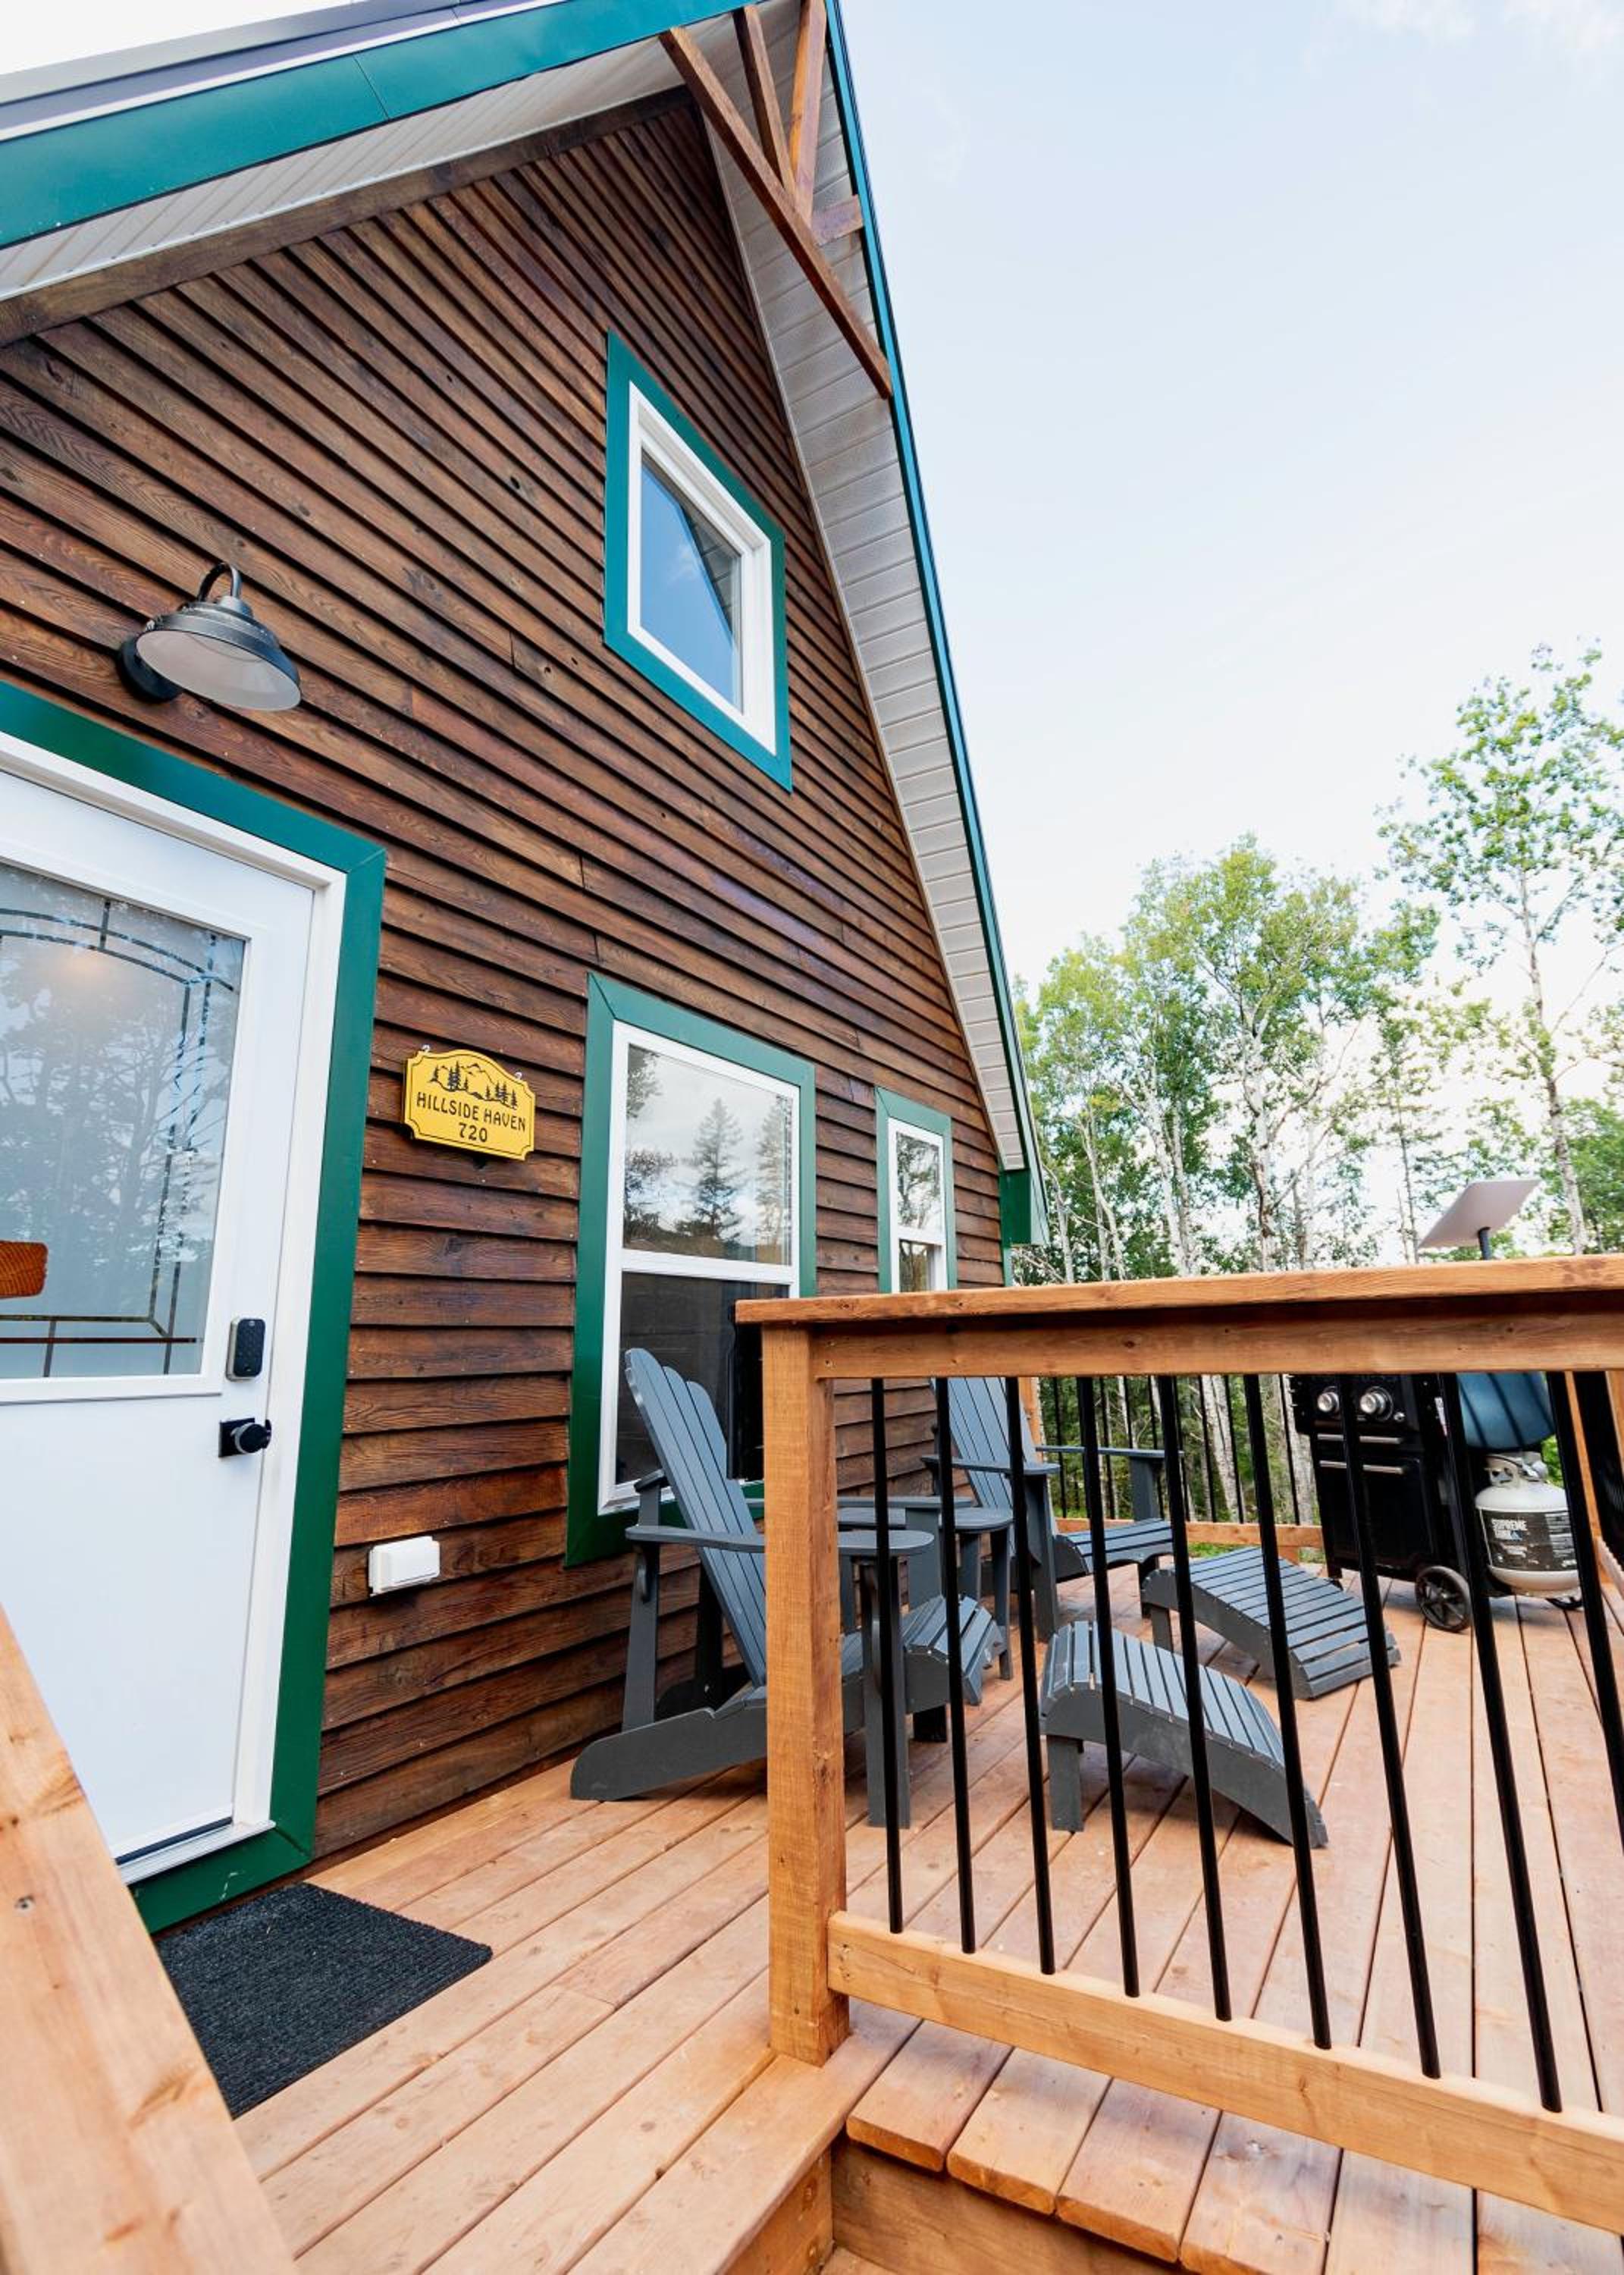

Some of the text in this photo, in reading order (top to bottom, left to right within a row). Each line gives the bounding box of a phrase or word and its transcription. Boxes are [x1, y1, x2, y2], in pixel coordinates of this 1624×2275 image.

[417, 1092, 526, 1131] HILLSIDE HAVEN
[459, 1123, 488, 1143] 720
